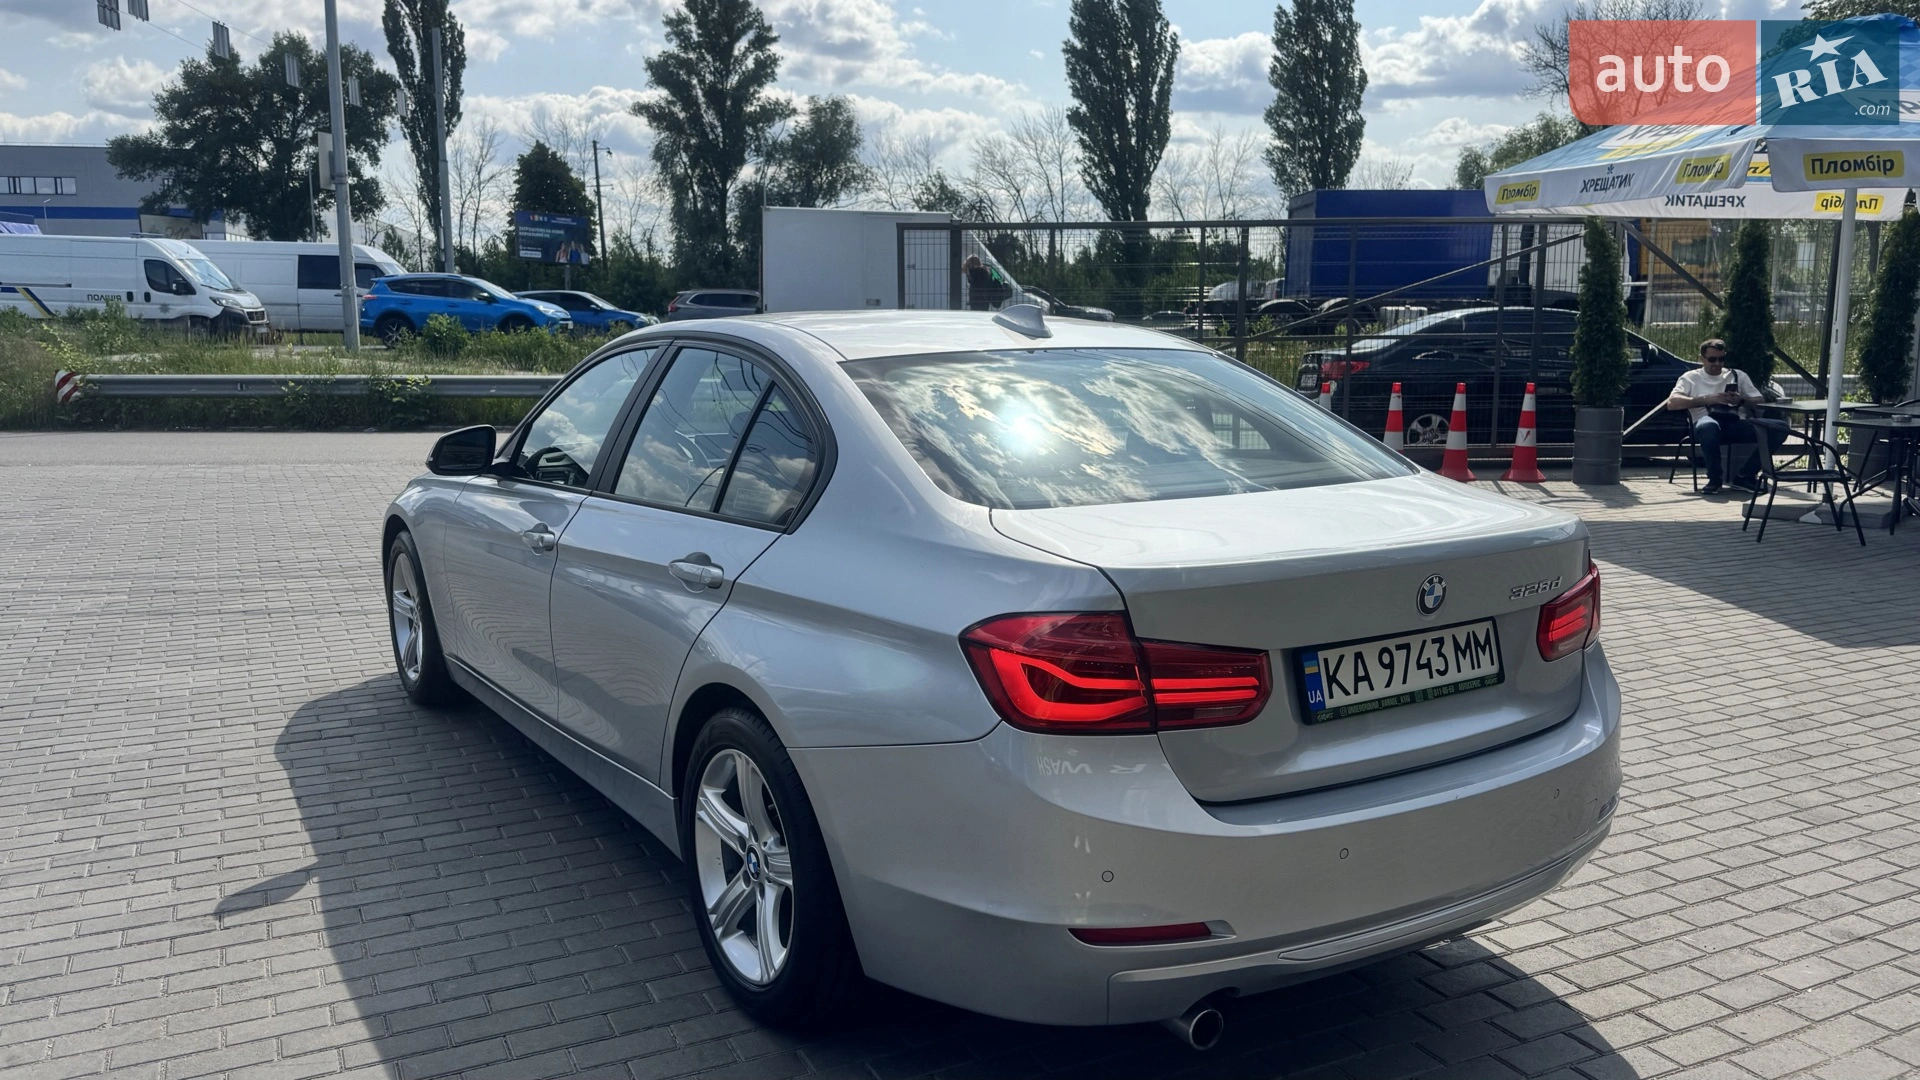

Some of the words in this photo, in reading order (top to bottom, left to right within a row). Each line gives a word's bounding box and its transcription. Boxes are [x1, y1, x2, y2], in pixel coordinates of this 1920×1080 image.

[1682, 158, 1725, 179] Пломбр
[1811, 154, 1896, 176] Пломбір
[1579, 172, 1635, 194] ХРЕЩАТИК
[1423, 576, 1447, 591] BMW
[1509, 576, 1563, 601] 328d
[1323, 651, 1375, 700] KA
[1378, 636, 1449, 689] 9743
[1452, 627, 1495, 673] MM
[1308, 689, 1324, 704] UA
